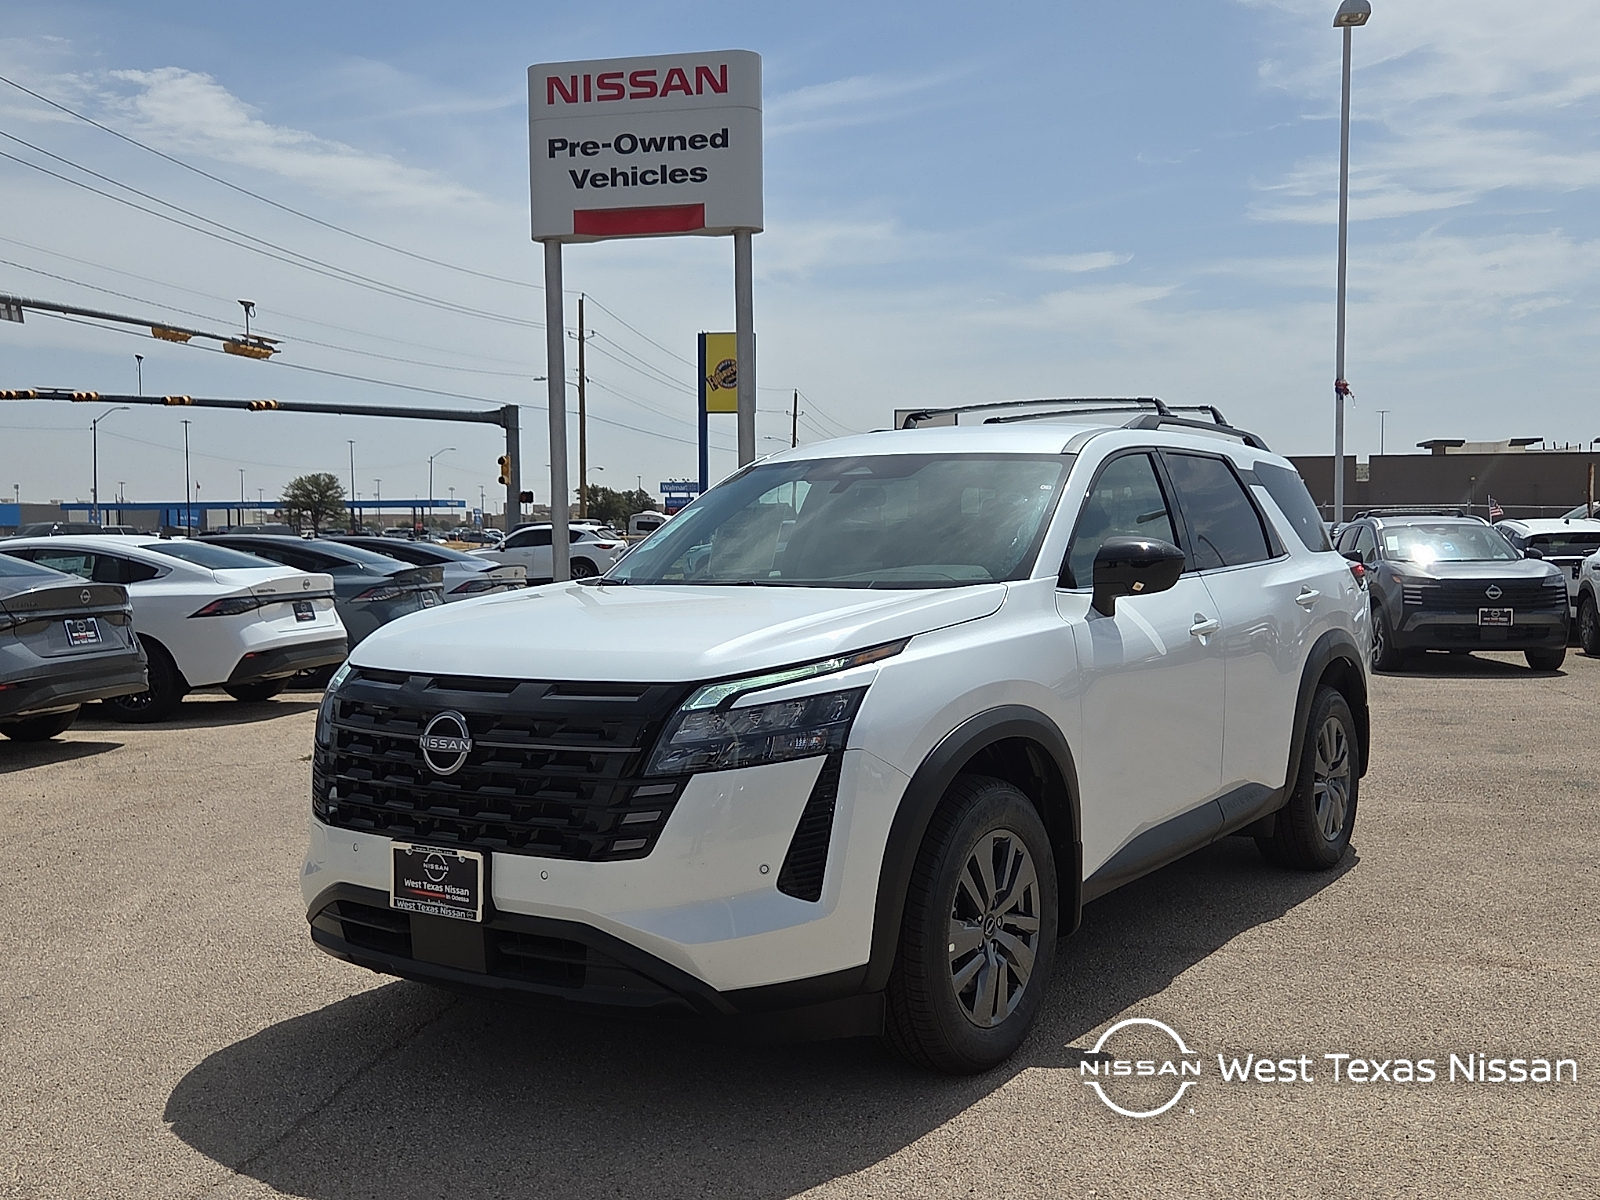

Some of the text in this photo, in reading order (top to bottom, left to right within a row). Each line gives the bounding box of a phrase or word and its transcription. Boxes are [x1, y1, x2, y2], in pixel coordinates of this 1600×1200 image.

[546, 64, 728, 105] NISSAN
[548, 128, 729, 159] Pre-Owned
[569, 164, 708, 189] Vehicles
[420, 737, 470, 750] NISSAN
[423, 863, 449, 871] NISSAN
[404, 878, 469, 896] West Texas Nissan
[396, 899, 416, 909] West
[417, 902, 439, 913] Texas
[440, 906, 466, 918] Nissan
